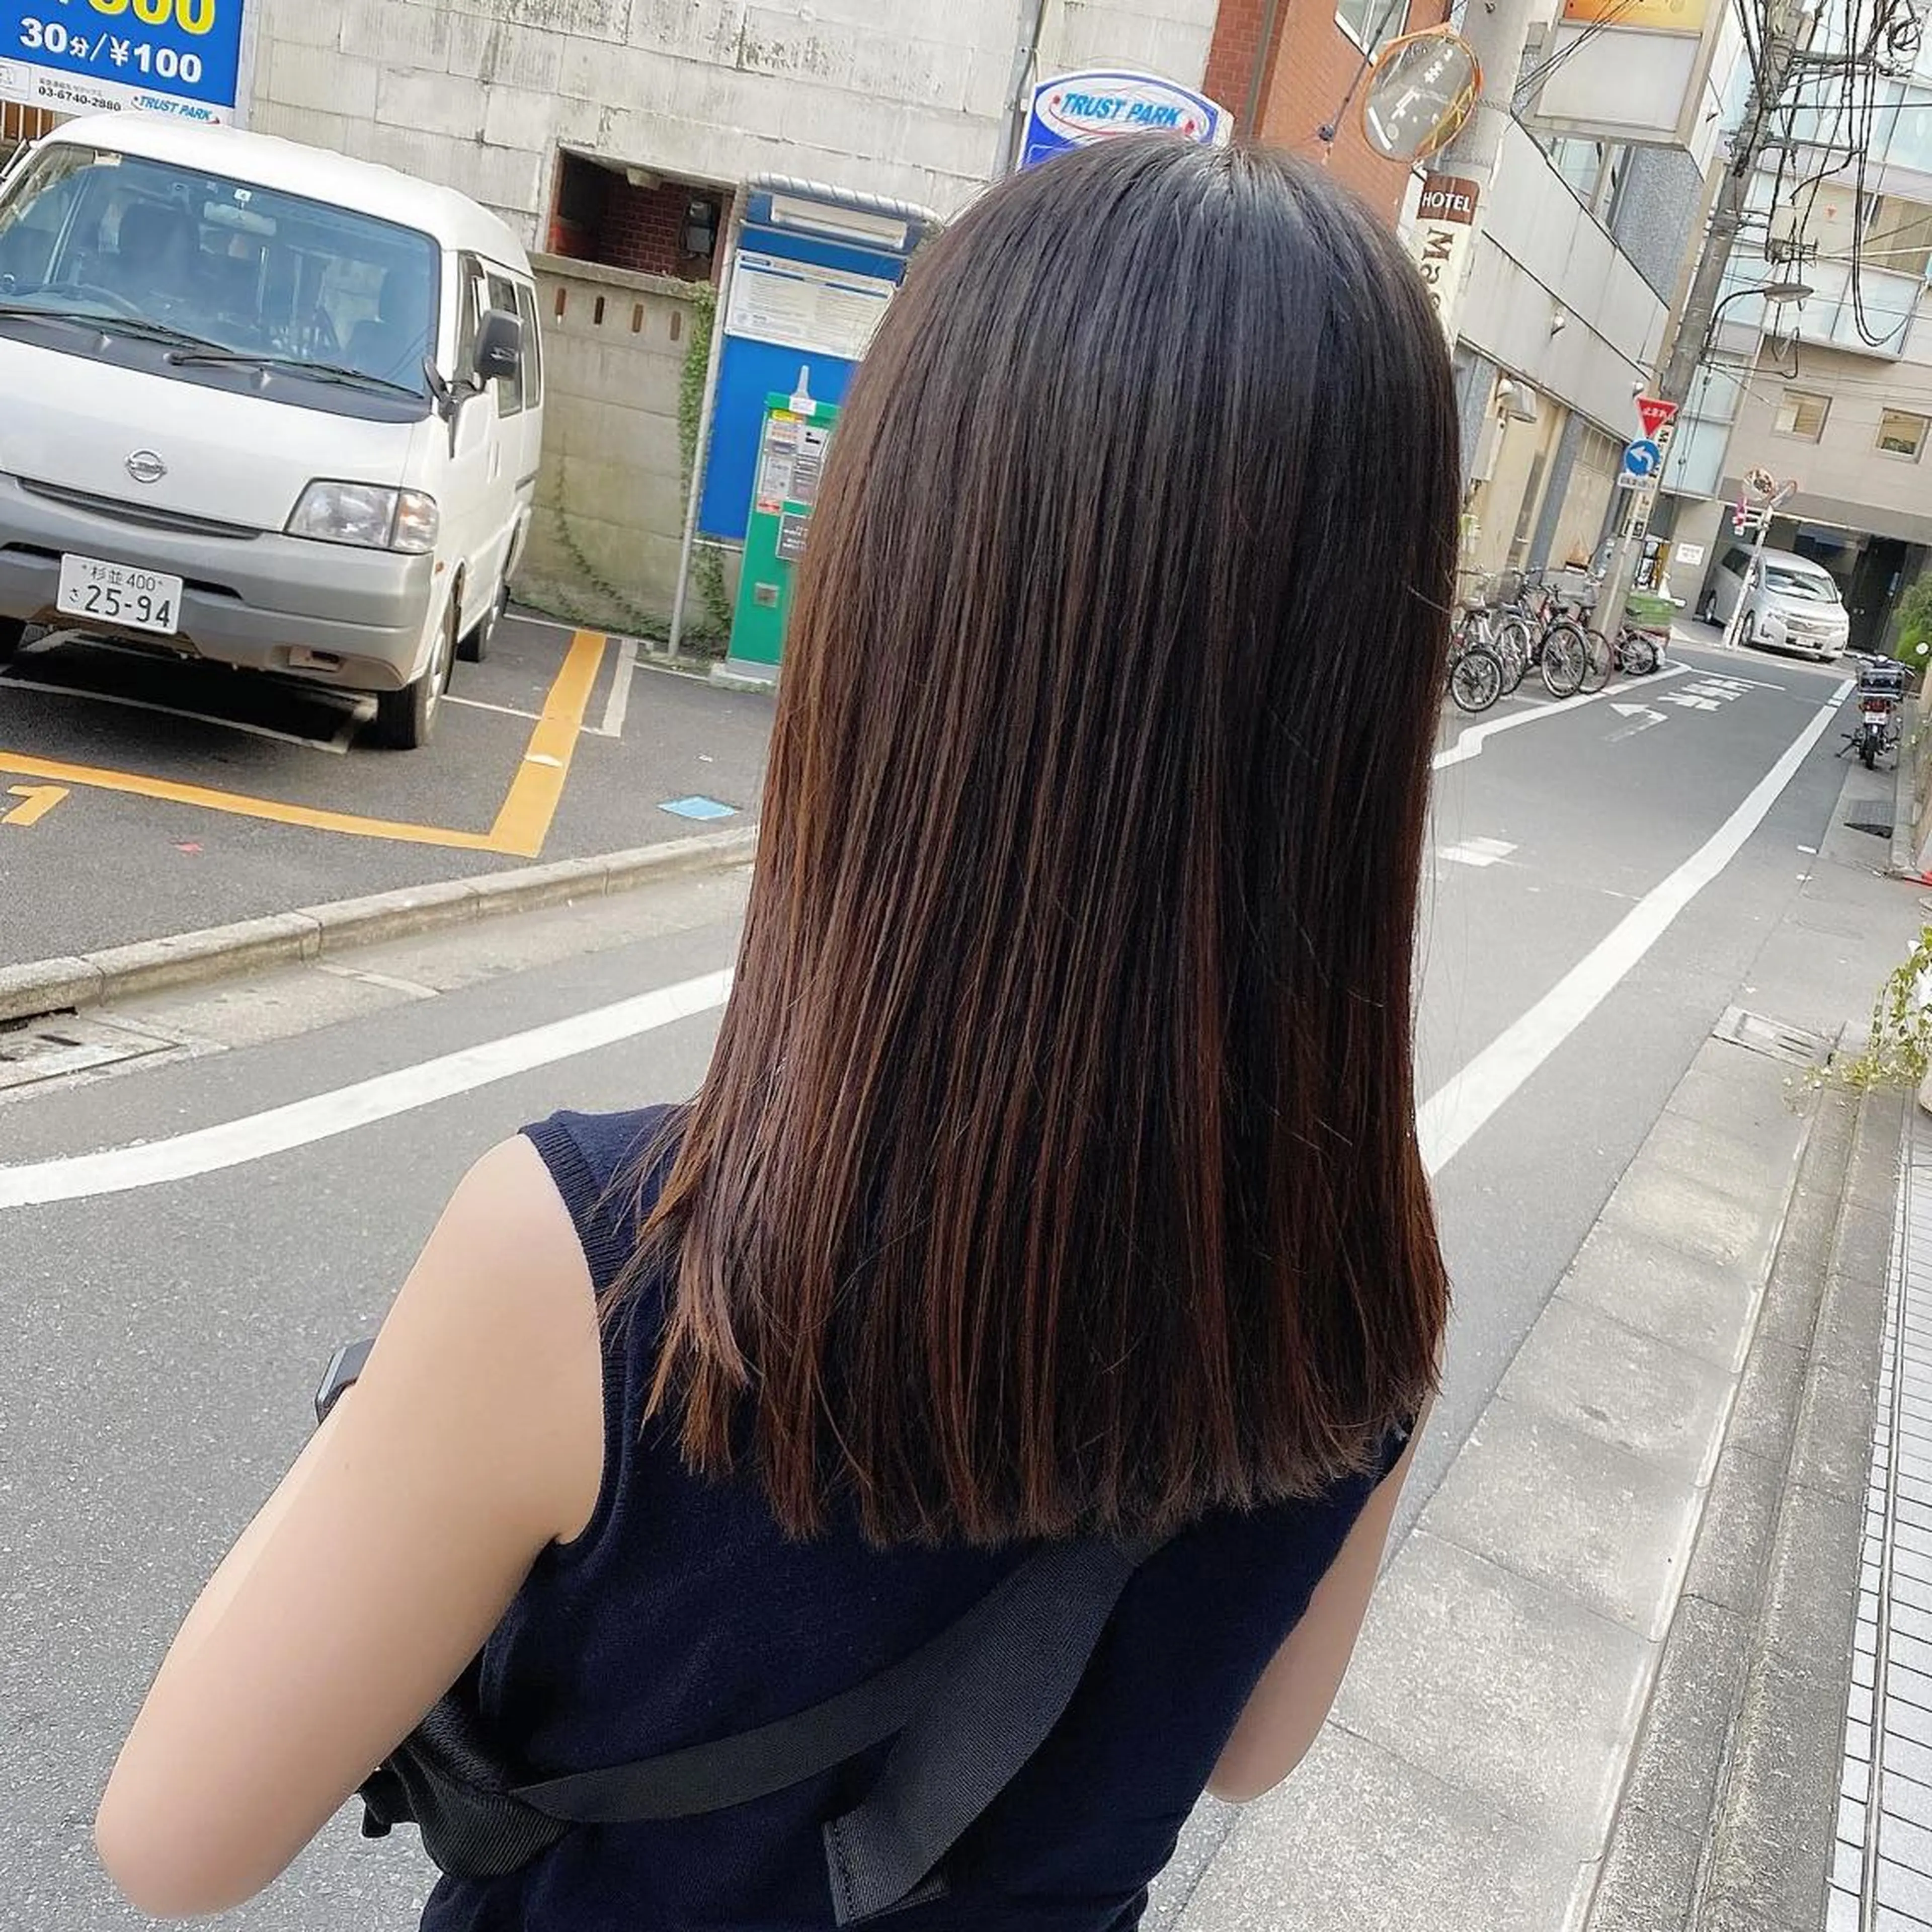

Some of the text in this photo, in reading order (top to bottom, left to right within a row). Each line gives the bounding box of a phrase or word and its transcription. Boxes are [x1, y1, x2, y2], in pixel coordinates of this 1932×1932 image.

[139, 96, 213, 121] TRUST PARK
[1060, 93, 1185, 126] TRUST PARK
[1421, 191, 1471, 212] HOTEL
[85, 585, 170, 627] 25-94
